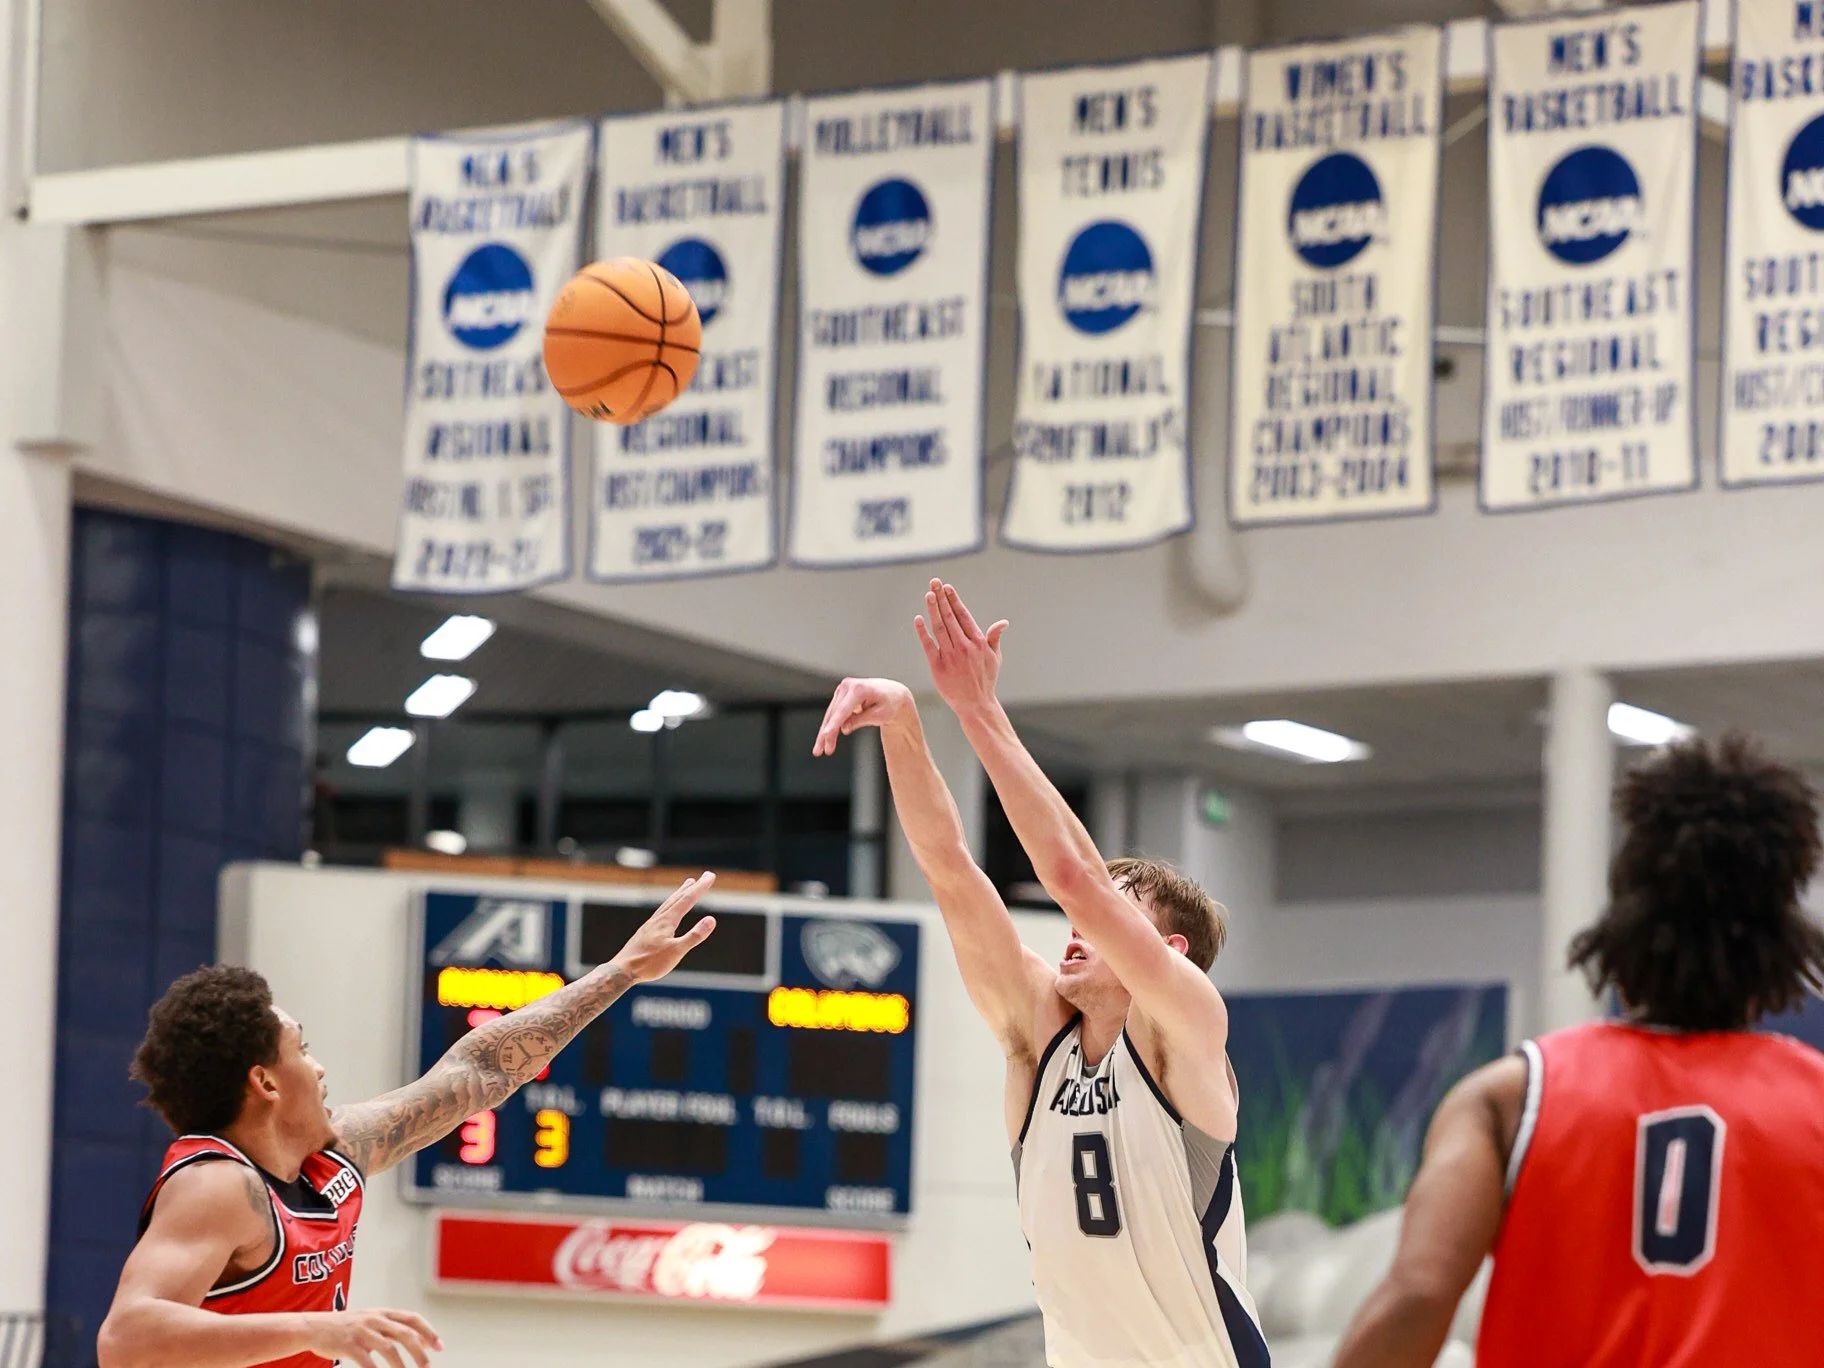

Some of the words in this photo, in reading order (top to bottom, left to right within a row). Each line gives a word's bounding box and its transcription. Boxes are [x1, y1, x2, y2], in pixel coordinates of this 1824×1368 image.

[1547, 24, 1643, 74] MEN'S
[1283, 51, 1409, 101] WOMEN'S
[1073, 86, 1158, 137] MEN'S
[1249, 95, 1429, 150] BASKETBALL
[1502, 73, 1684, 135] BASKETBALL
[657, 117, 733, 166] MEN'S
[815, 103, 974, 157] VOLLEYBALL
[1063, 148, 1165, 198] TENNIS
[616, 174, 768, 226] BASKETBALL
[1292, 203, 1385, 246] NCAA
[1541, 196, 1642, 247] NCAA
[1061, 271, 1160, 309] NCAA
[1290, 274, 1378, 317] SOUTH
[1498, 271, 1680, 332] SOUTHEAST
[811, 296, 967, 348] SOUTHEAST
[1268, 319, 1402, 366] ATLANTIC
[1510, 331, 1662, 385] REGIONAL
[824, 366, 944, 412] REGIONAL
[1264, 366, 1397, 411] REGIONAL
[823, 427, 948, 477] CHAMPIONS
[1251, 410, 1412, 457] CHAMPIONS
[1249, 456, 1410, 503] 2003-2004
[1527, 444, 1650, 494] 2010-11
[534, 1108, 570, 1168] 3
[321, 1166, 358, 1208] PBC
[1071, 1130, 1124, 1239] 8
[1632, 1104, 1728, 1278] 0
[554, 1216, 782, 1300] Coca-Cola
